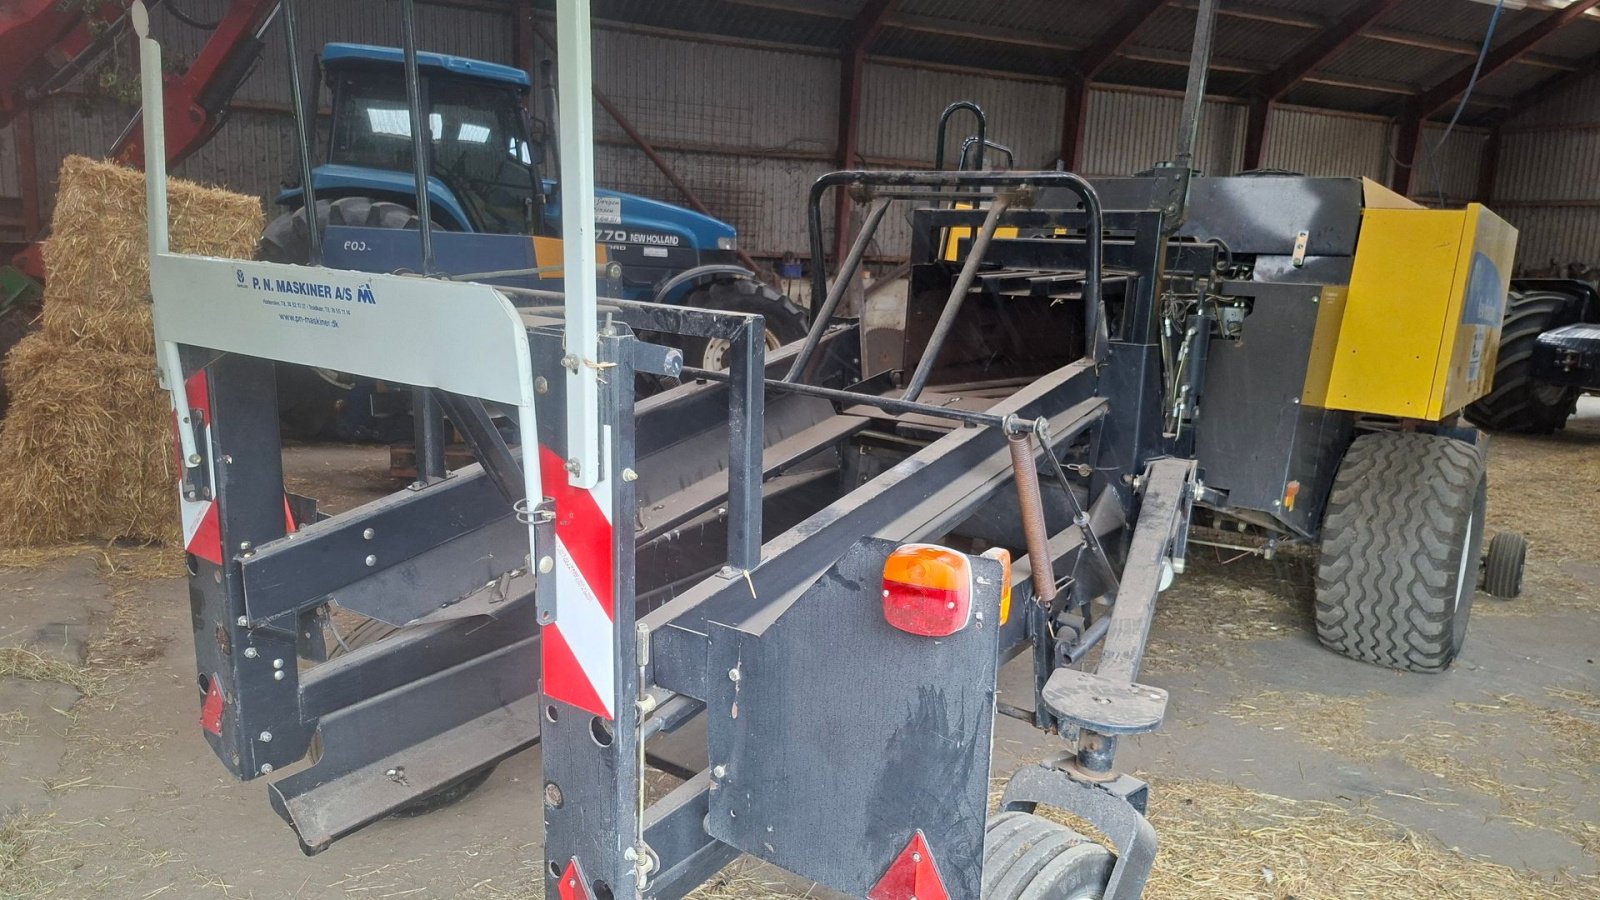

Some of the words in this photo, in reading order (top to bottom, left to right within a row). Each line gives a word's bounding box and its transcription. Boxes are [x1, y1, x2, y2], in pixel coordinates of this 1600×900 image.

[630, 233, 646, 244] NEW
[646, 235, 679, 246] HOLLAND
[252, 277, 261, 290] P.
[263, 278, 274, 292] N.
[276, 280, 332, 299] MASKINER
[335, 287, 353, 302] A/S
[278, 313, 340, 329] www.pn-maskiner.dk
